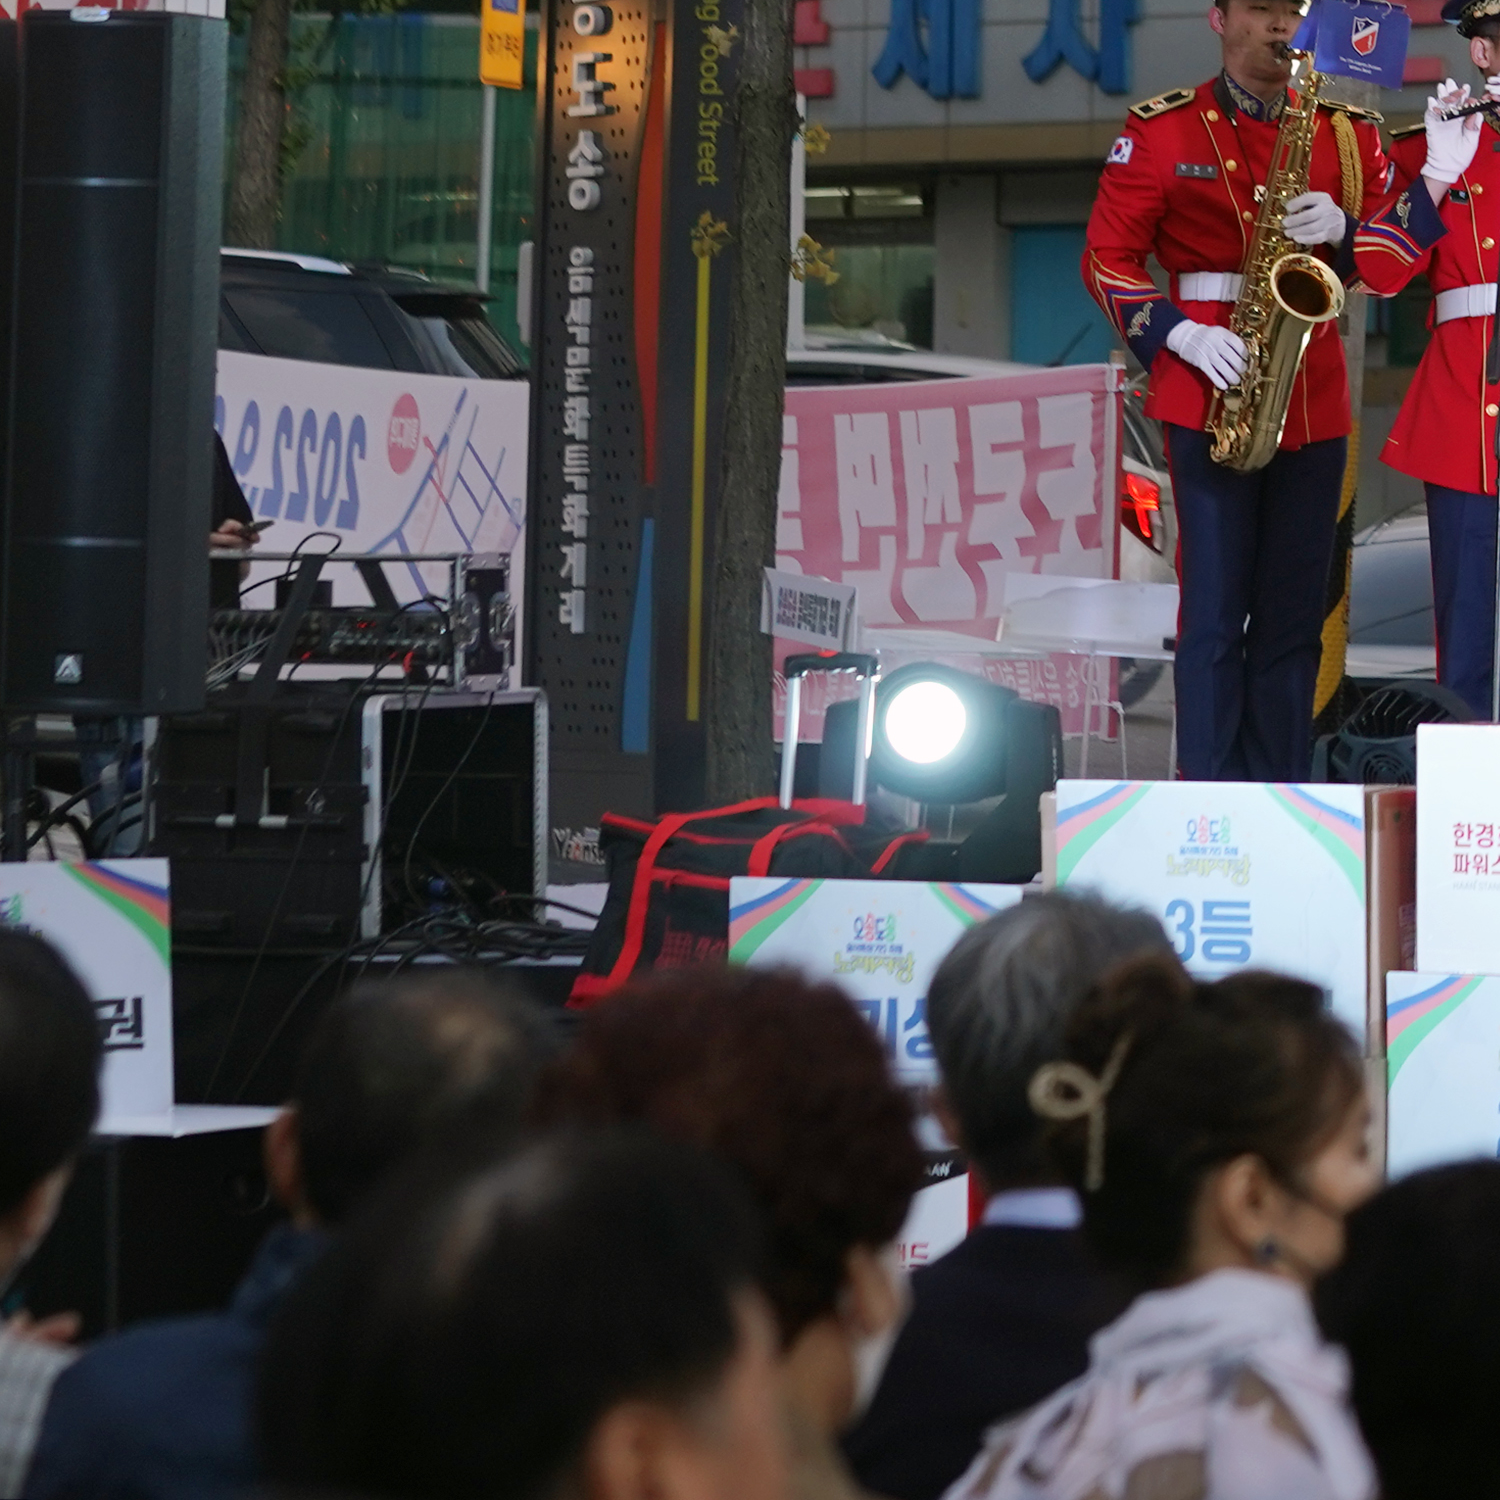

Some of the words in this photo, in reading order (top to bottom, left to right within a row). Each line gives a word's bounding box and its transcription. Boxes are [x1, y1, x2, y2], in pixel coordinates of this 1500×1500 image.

[697, 102, 723, 187] Street
[1187, 815, 1231, 844] 오송도송
[1165, 899, 1253, 964] 3등
